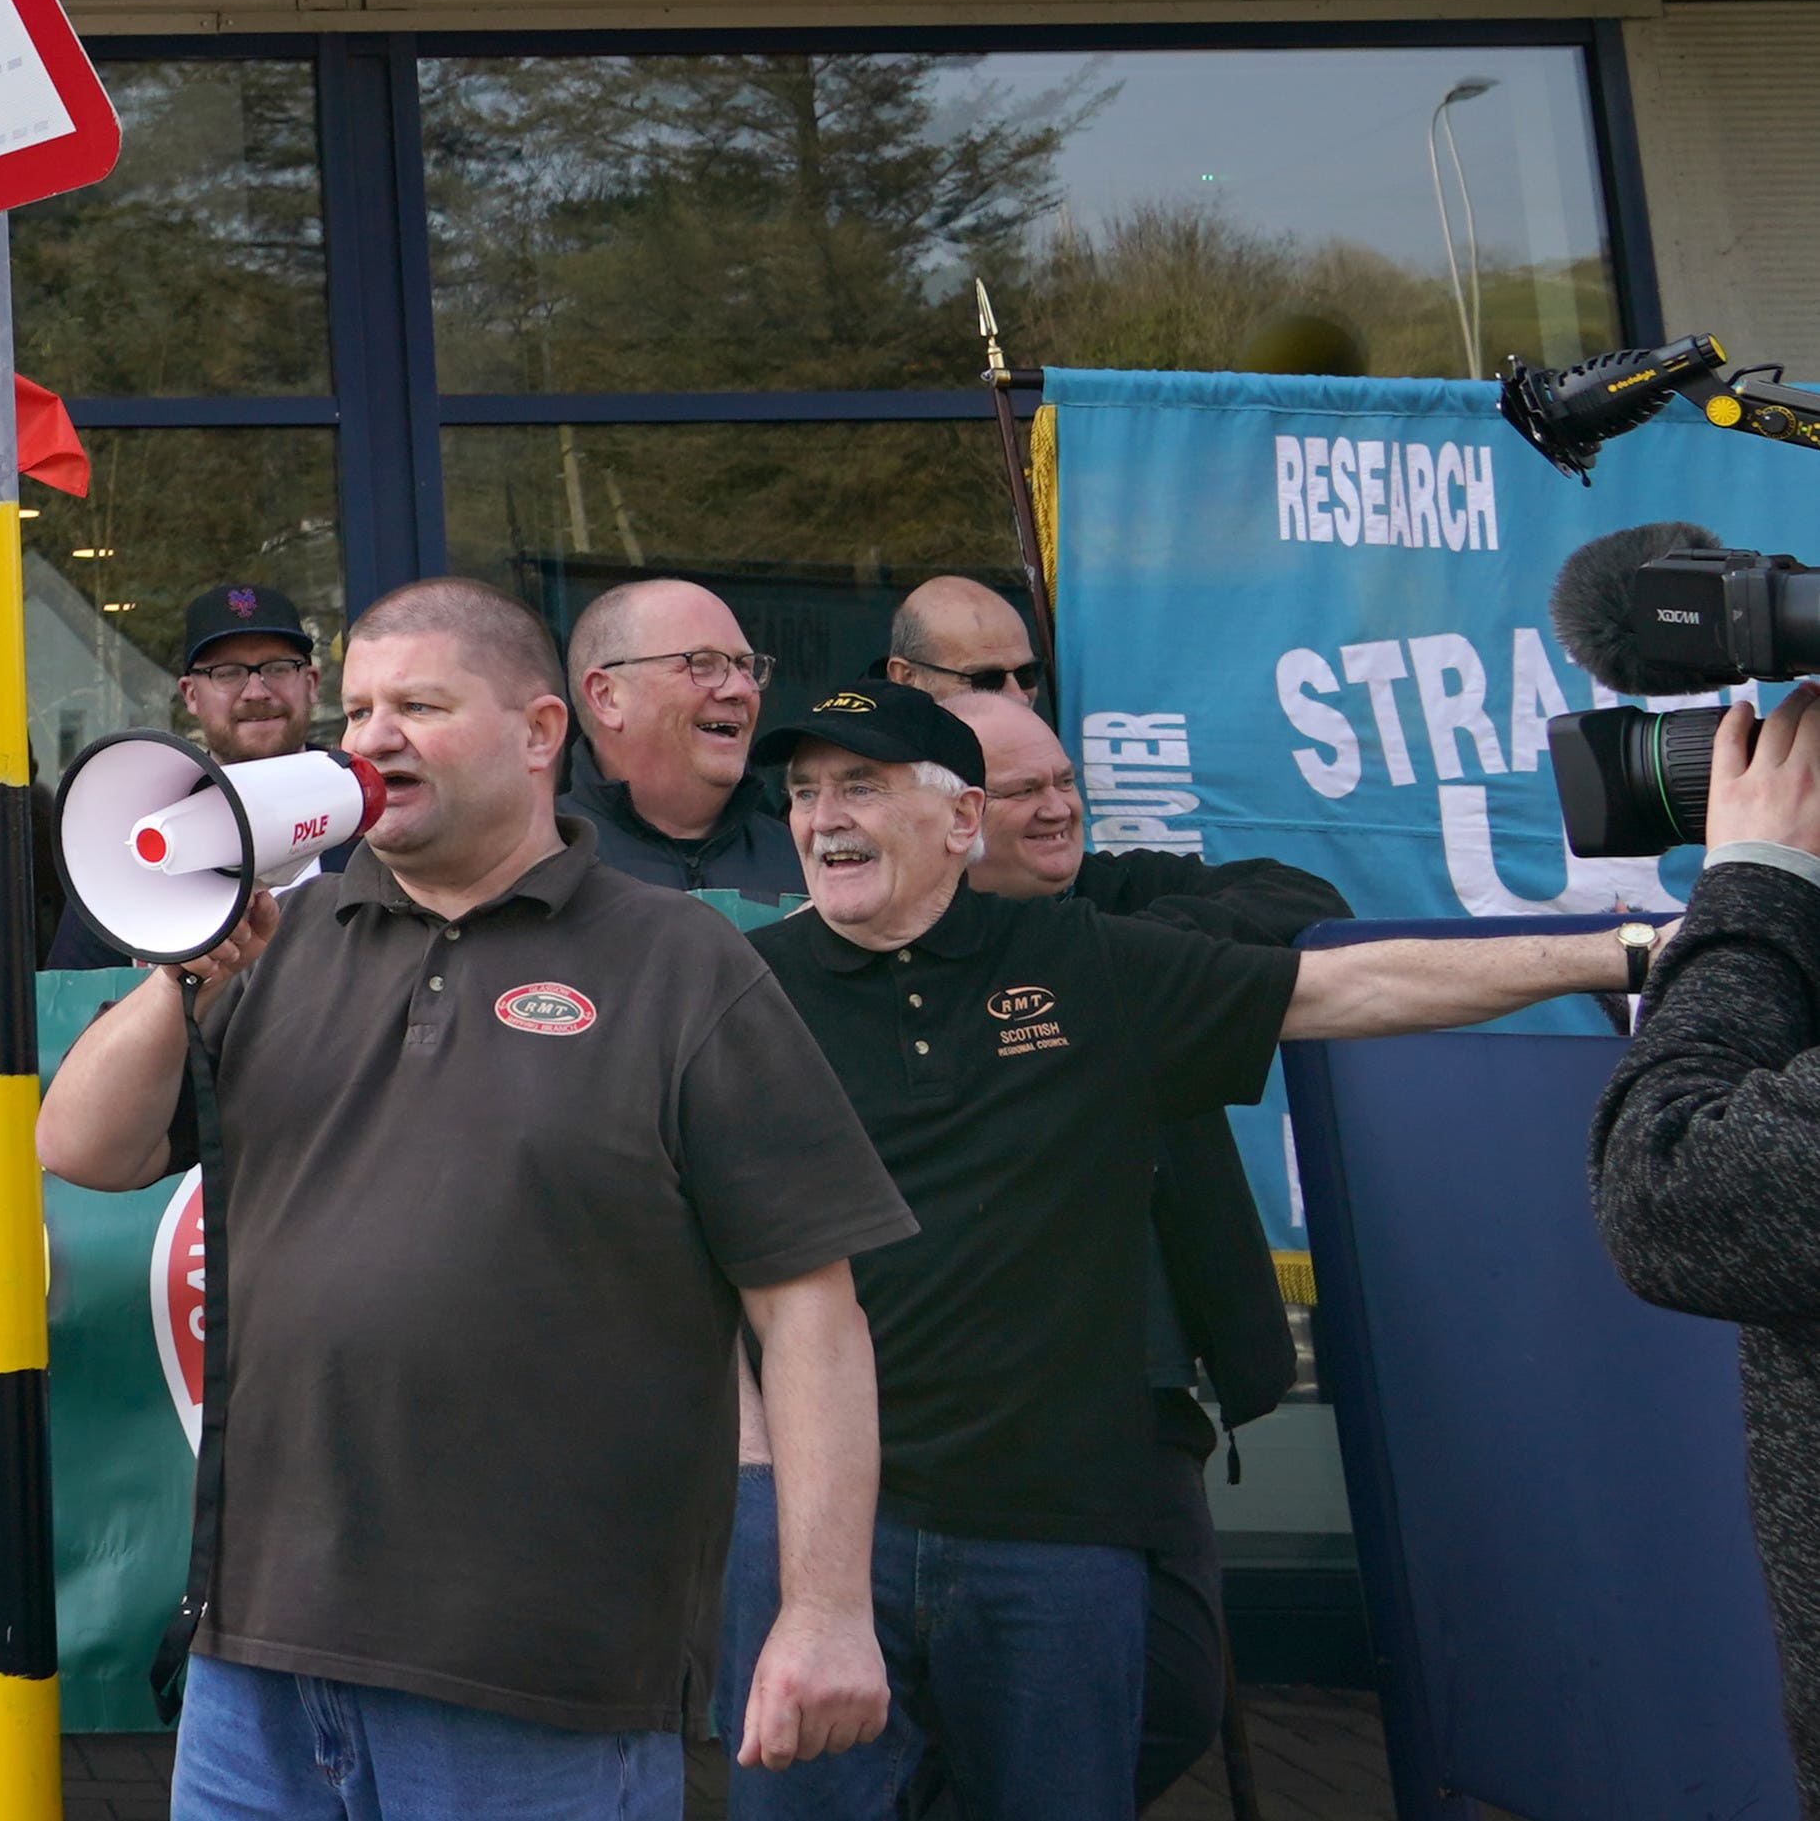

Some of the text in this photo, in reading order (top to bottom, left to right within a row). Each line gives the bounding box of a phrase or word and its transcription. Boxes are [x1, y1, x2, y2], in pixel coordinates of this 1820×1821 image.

[1275, 435, 1499, 551] RESEARCH
[1657, 609, 1700, 624] XDCAM
[292, 814, 329, 845] PYLE
[525, 1001, 568, 1016] RMT
[1002, 994, 1042, 1013] RMT
[1000, 1022, 1060, 1044] SCOTTISH
